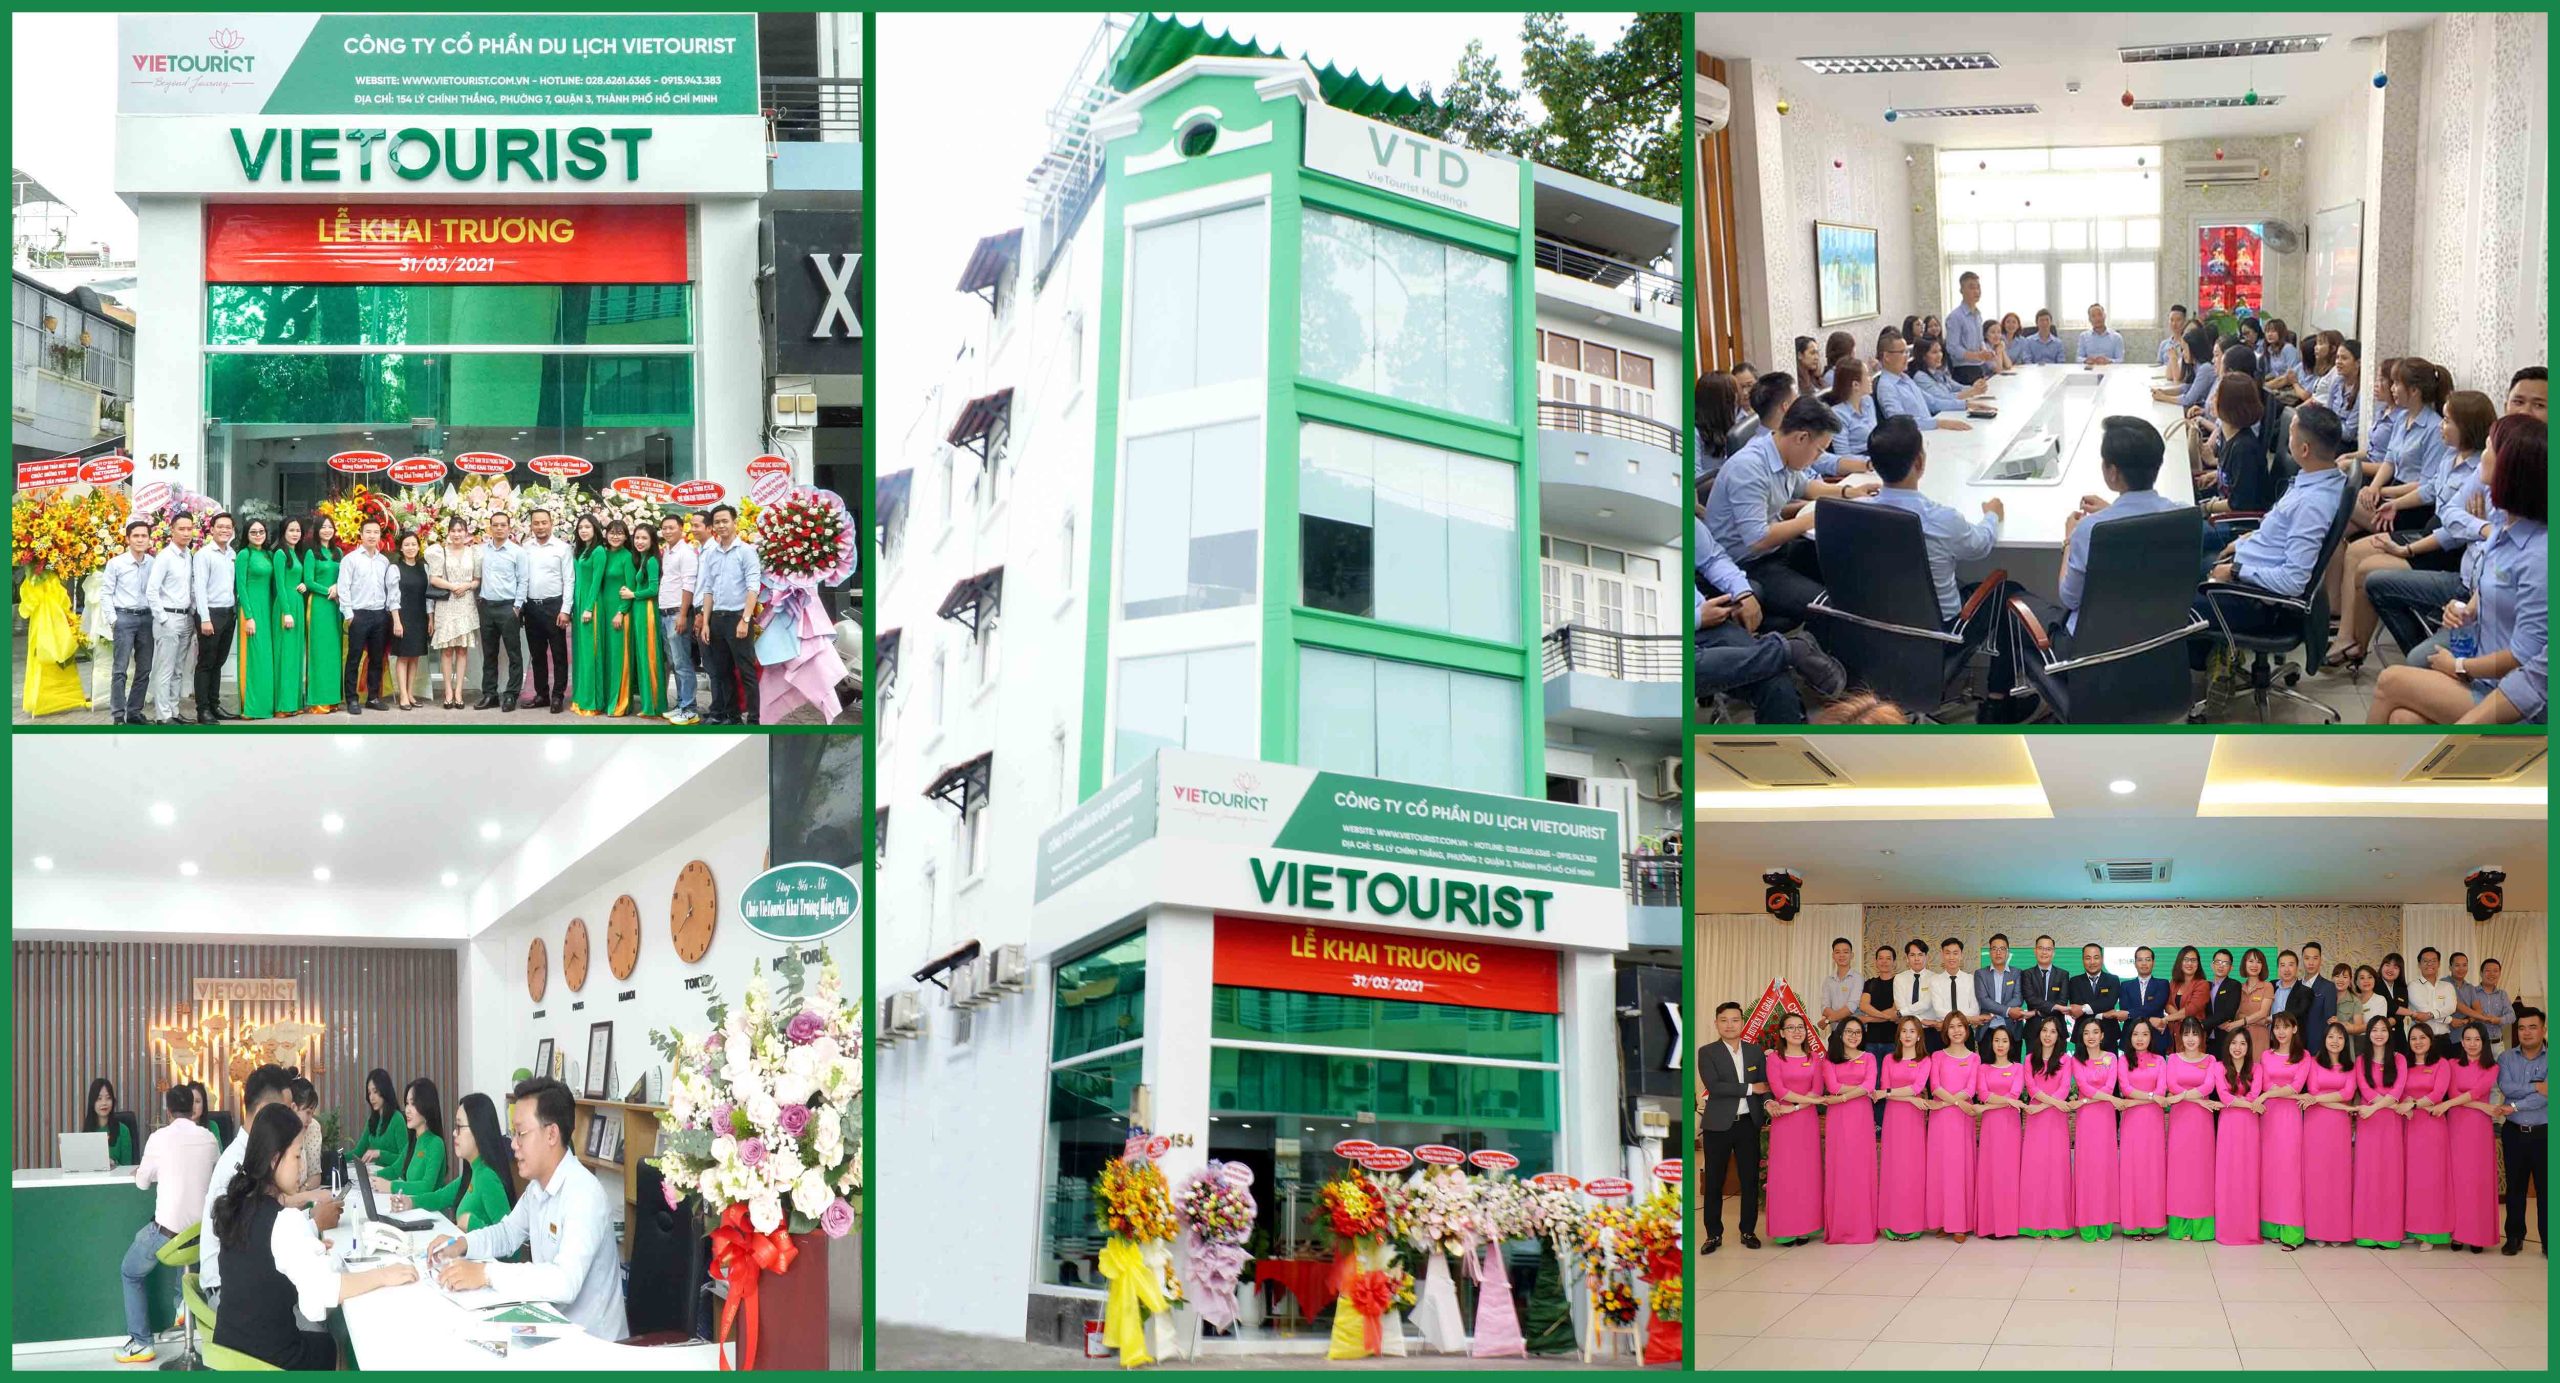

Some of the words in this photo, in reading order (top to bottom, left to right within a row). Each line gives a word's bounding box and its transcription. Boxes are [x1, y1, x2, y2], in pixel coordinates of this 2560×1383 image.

[343, 33, 407, 55] CÔNG
[411, 38, 436, 55] TY
[441, 31, 473, 55] CỔ
[479, 32, 533, 55] PHẦN
[538, 37, 566, 54] DU
[573, 37, 617, 59] LỊCH
[622, 37, 737, 54] VIETOURIST
[131, 49, 255, 73] VIETOURIST
[355, 76, 400, 85] WEBSITE:
[402, 76, 530, 86] WWW.VIETOURIST.COM.VN
[540, 76, 583, 85] HOTLINE:
[585, 76, 651, 86] 028.6261.6365
[661, 76, 722, 86] 0915.943.383
[354, 94, 372, 105] ĐỊA
[396, 94, 412, 104] 154
[414, 92, 425, 104] LÝ
[427, 92, 458, 104] CHÍNH
[500, 92, 543, 104] PHƯỜNG
[554, 93, 582, 106] QUẬN
[585, 95, 594, 105] 3,
[596, 92, 629, 104] THÀNH
[672, 92, 691, 104] CHÍ
[693, 94, 718, 104] MINH
[229, 127, 654, 183] VIETOURIST
[1367, 126, 1469, 188] VTD
[1421, 184, 1469, 209] Holdings
[318, 207, 351, 243] LỄ
[360, 218, 432, 243] KHAI
[441, 216, 576, 243] TRƯƠNG
[399, 255, 495, 273] 31/03/2021
[809, 253, 864, 337] X
[149, 453, 181, 470] 154
[1173, 785, 1268, 812] VIETOURIST
[1334, 790, 1381, 811] CÔNG
[1384, 798, 1402, 813] TY
[1405, 798, 1428, 817] CỔ
[1432, 803, 1470, 823] PHẦN
[1473, 811, 1494, 826] DU
[1497, 815, 1528, 832] LỊCH
[1530, 818, 1607, 841] VIETOURIST
[1250, 857, 1554, 932] VIETOURIST
[1290, 927, 1317, 959] LỄ
[1323, 938, 1377, 965] KHAI
[1383, 944, 1481, 975] TRƯƠNG
[196, 979, 296, 1000] VIETOURIST
[1352, 974, 1424, 992] 31/03/2021
[1170, 1133, 1194, 1148] 154
